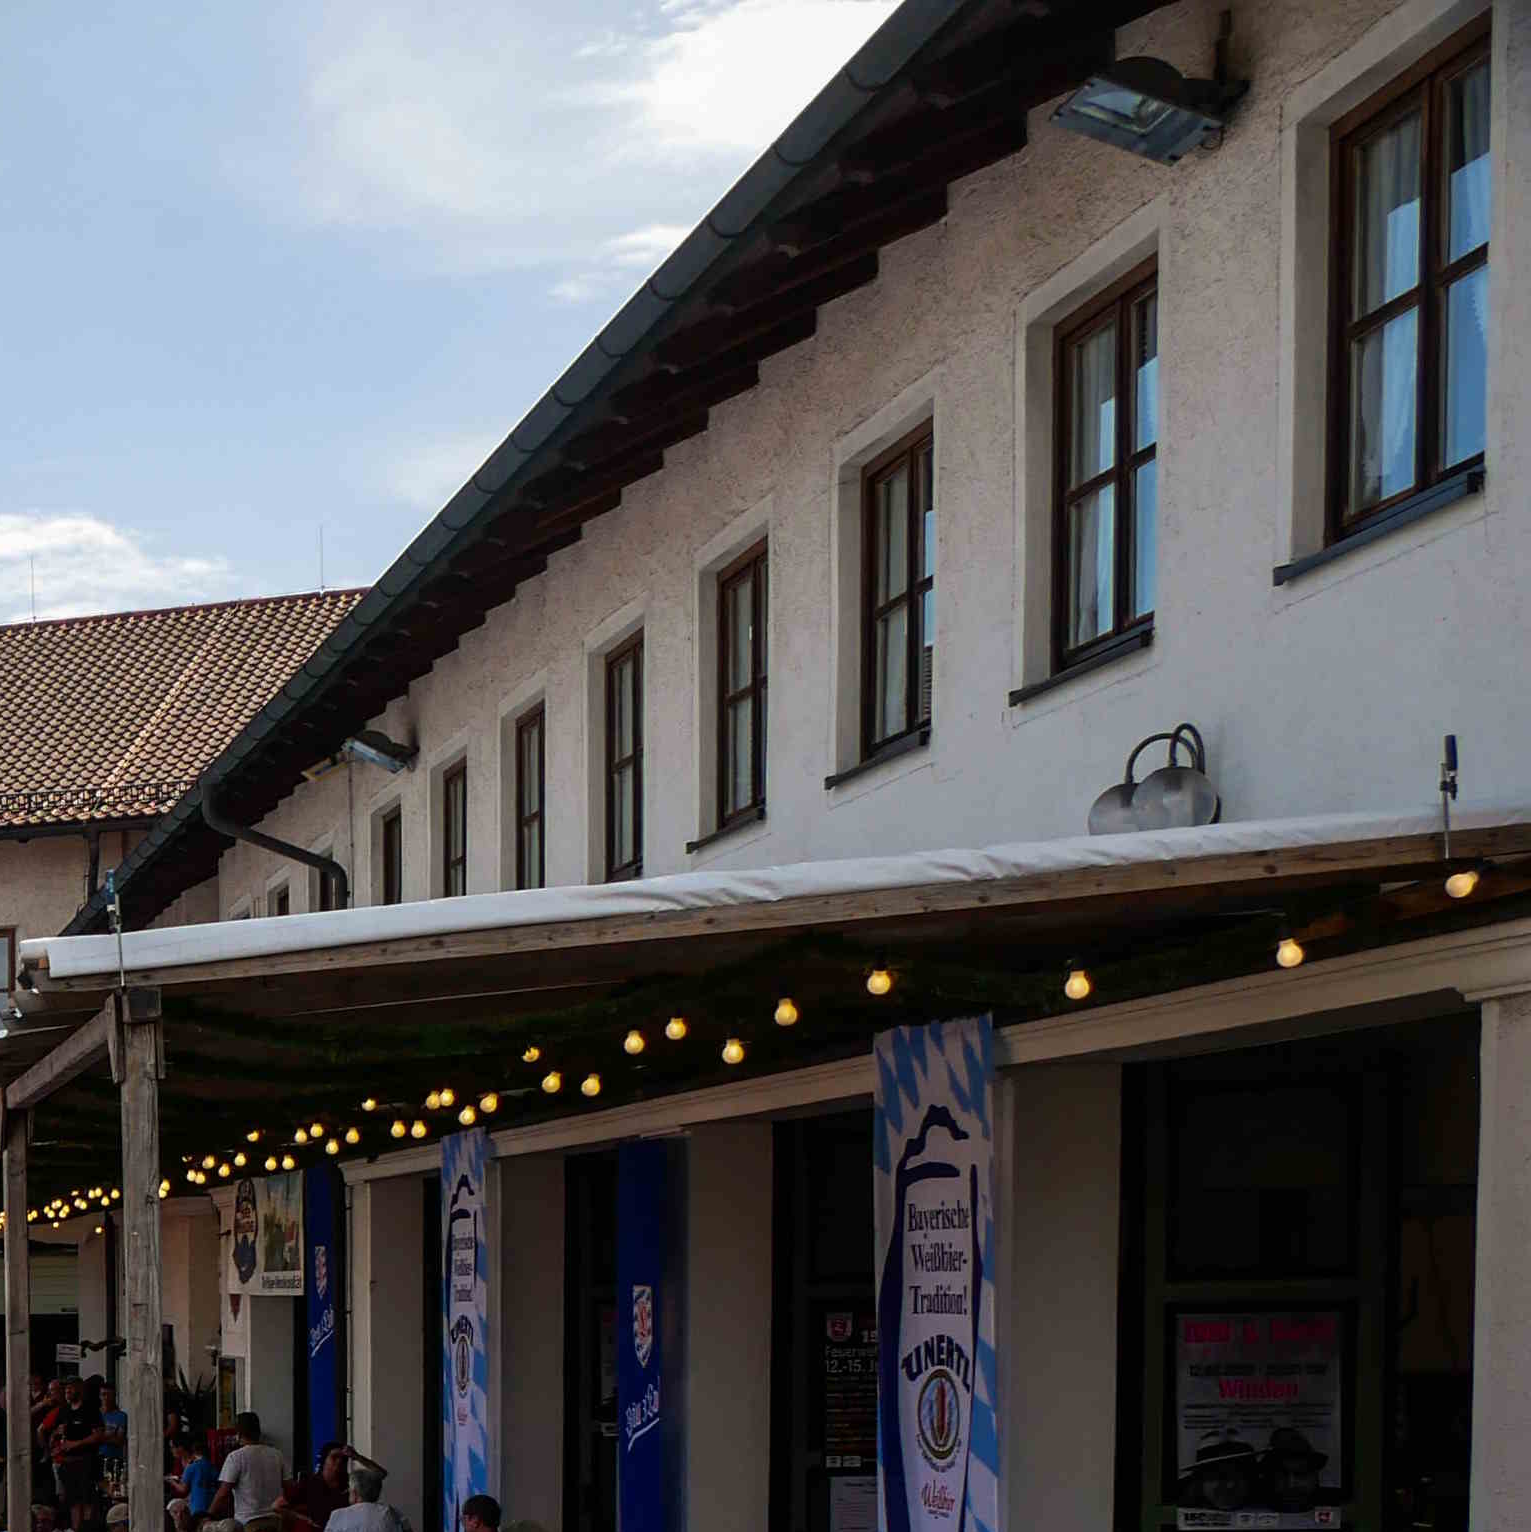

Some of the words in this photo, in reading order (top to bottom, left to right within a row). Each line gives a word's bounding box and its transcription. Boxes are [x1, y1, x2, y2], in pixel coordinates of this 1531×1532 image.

[908, 1200, 970, 1239] Bayerische
[912, 1241, 967, 1273] Weißbier-
[909, 1284, 968, 1315] Tradition!
[901, 1334, 971, 1393] UNERTL
